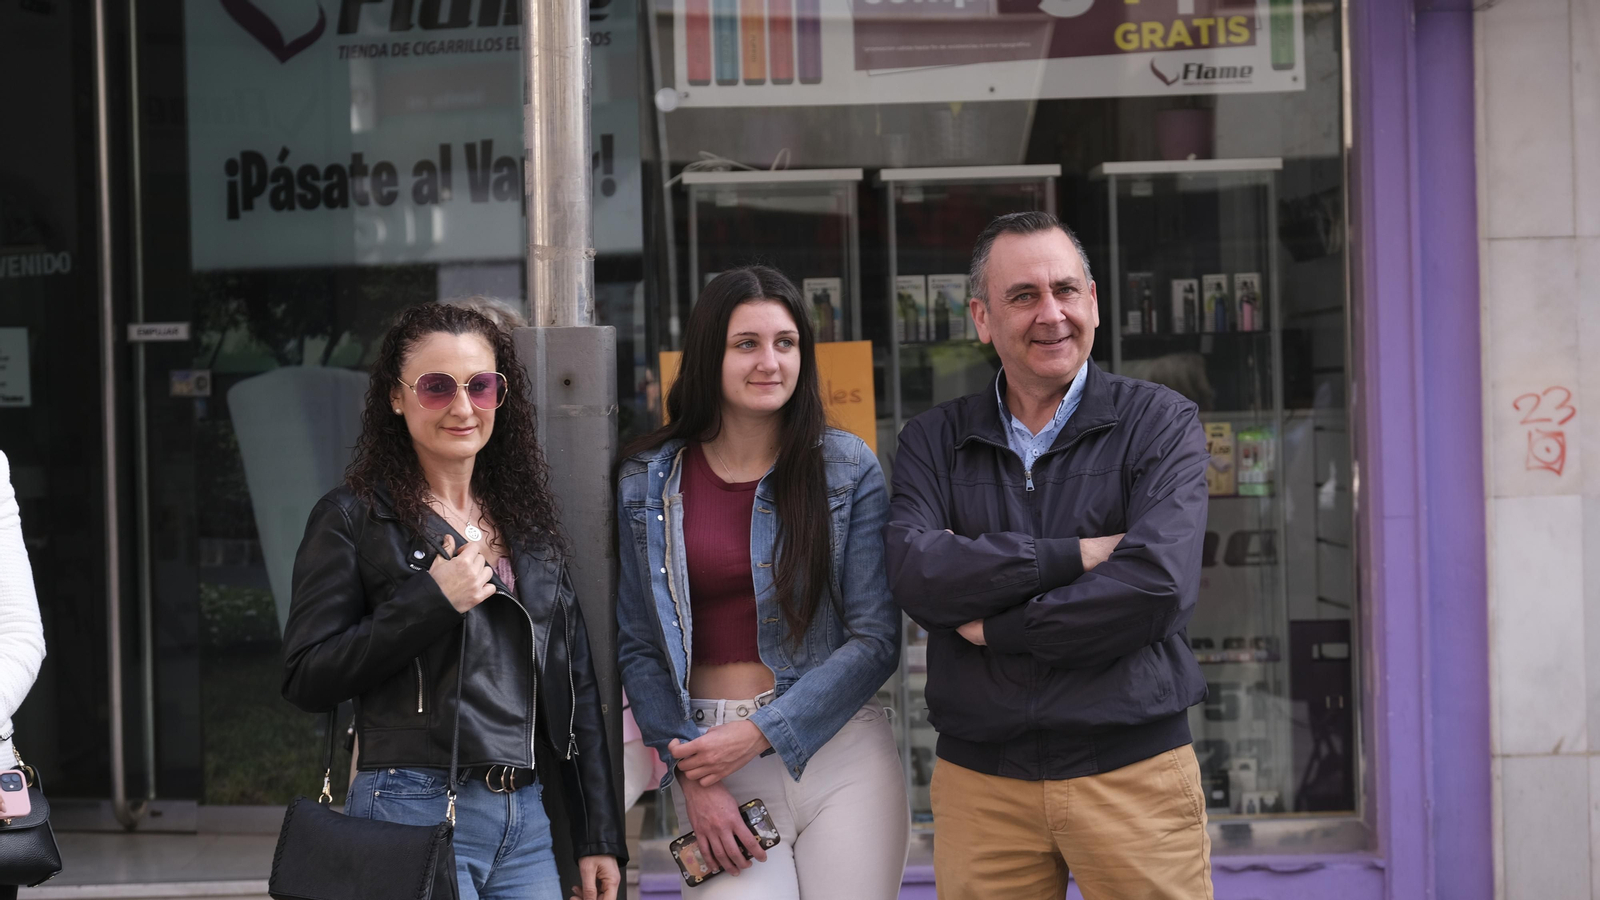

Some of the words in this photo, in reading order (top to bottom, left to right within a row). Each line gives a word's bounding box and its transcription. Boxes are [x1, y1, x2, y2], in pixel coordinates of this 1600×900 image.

[1114, 16, 1251, 51] GRATIS
[338, 43, 390, 60] TIENDA
[391, 41, 410, 57] DE
[412, 37, 502, 57] CIGARRILLOS
[1182, 62, 1254, 80] Flame
[224, 145, 399, 220] ¡Pásate
[411, 143, 453, 205] al
[136, 326, 179, 337] EMPUJAR
[1512, 385, 1577, 426] 23
